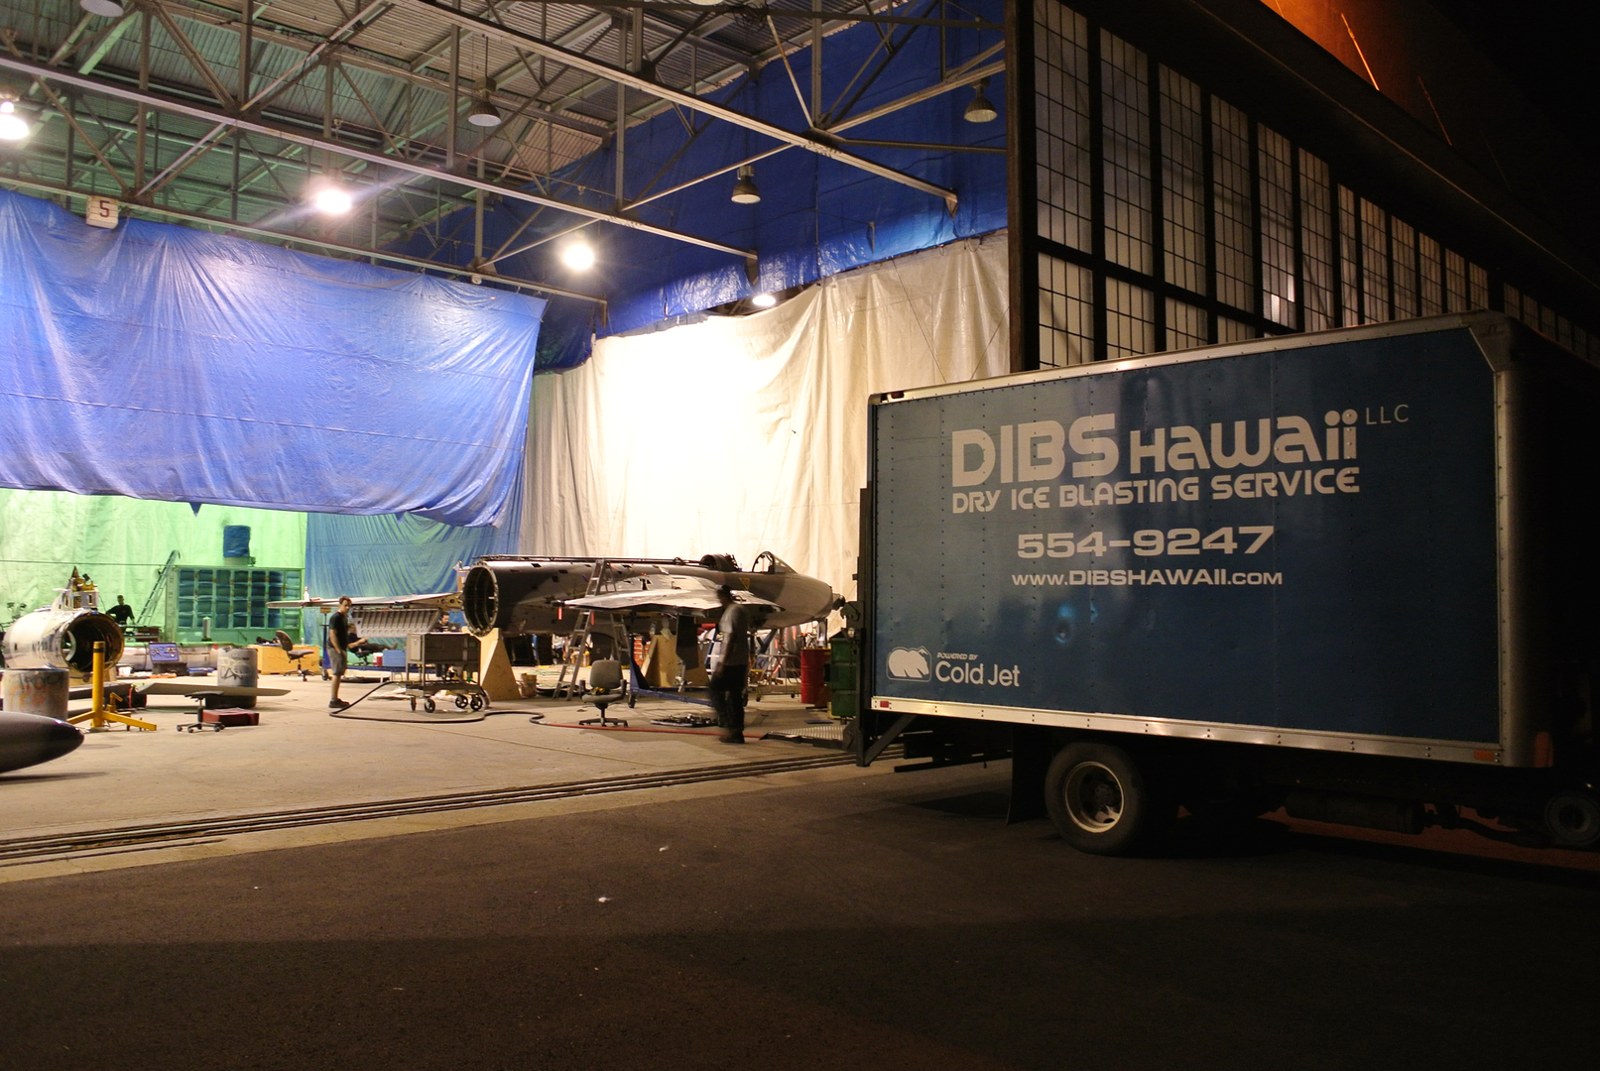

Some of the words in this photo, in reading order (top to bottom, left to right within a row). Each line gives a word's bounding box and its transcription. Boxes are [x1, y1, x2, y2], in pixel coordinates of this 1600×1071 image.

[99, 200, 110, 218] 5
[951, 413, 1119, 488] DIBS
[1365, 404, 1410, 426] LLC
[952, 491, 1001, 514] DRY
[1011, 486, 1050, 511] ICE
[1059, 476, 1200, 508] BLASTING
[1211, 467, 1361, 500] SERVICE
[1017, 526, 1275, 560] 554-9247
[935, 661, 984, 685] Cold
[988, 664, 1021, 687] Jet
